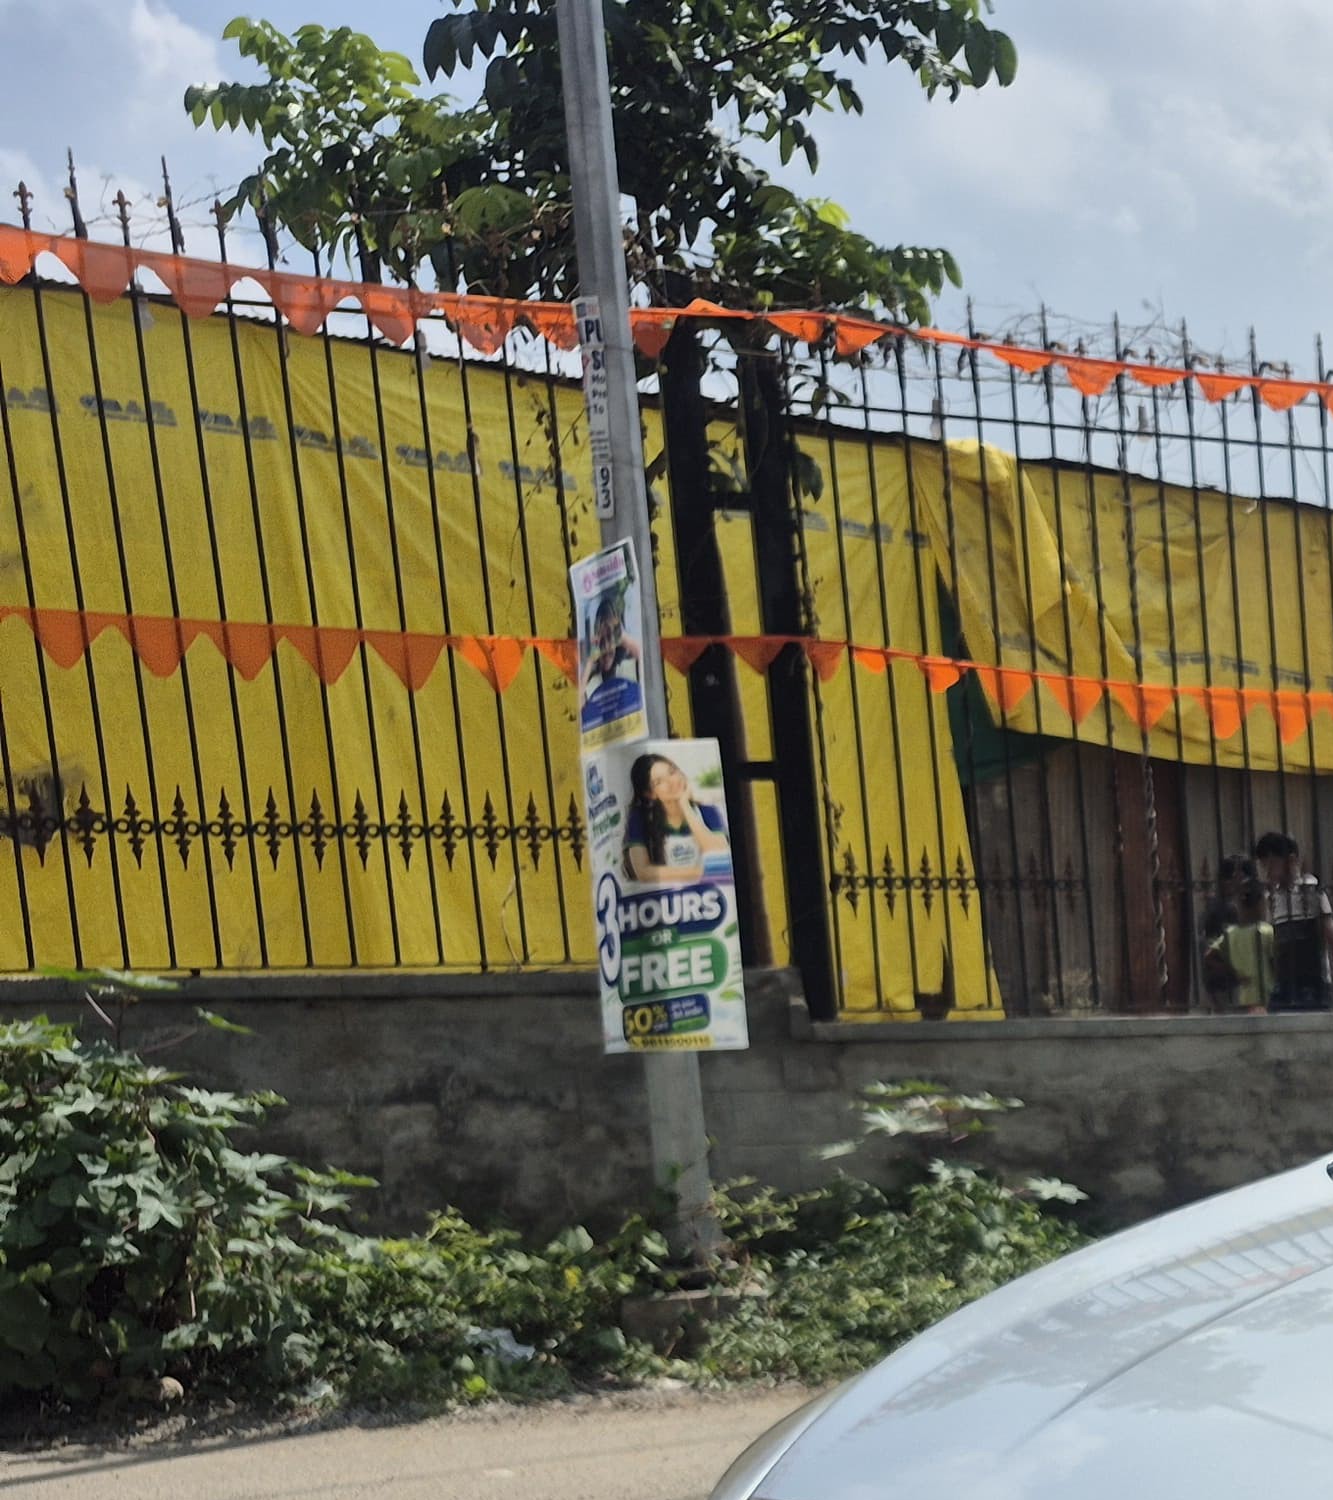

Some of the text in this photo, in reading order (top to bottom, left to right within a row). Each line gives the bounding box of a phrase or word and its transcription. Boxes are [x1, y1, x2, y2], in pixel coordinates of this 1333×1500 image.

[597, 873, 722, 986] 3 HOURS
[621, 945, 715, 995] FREE
